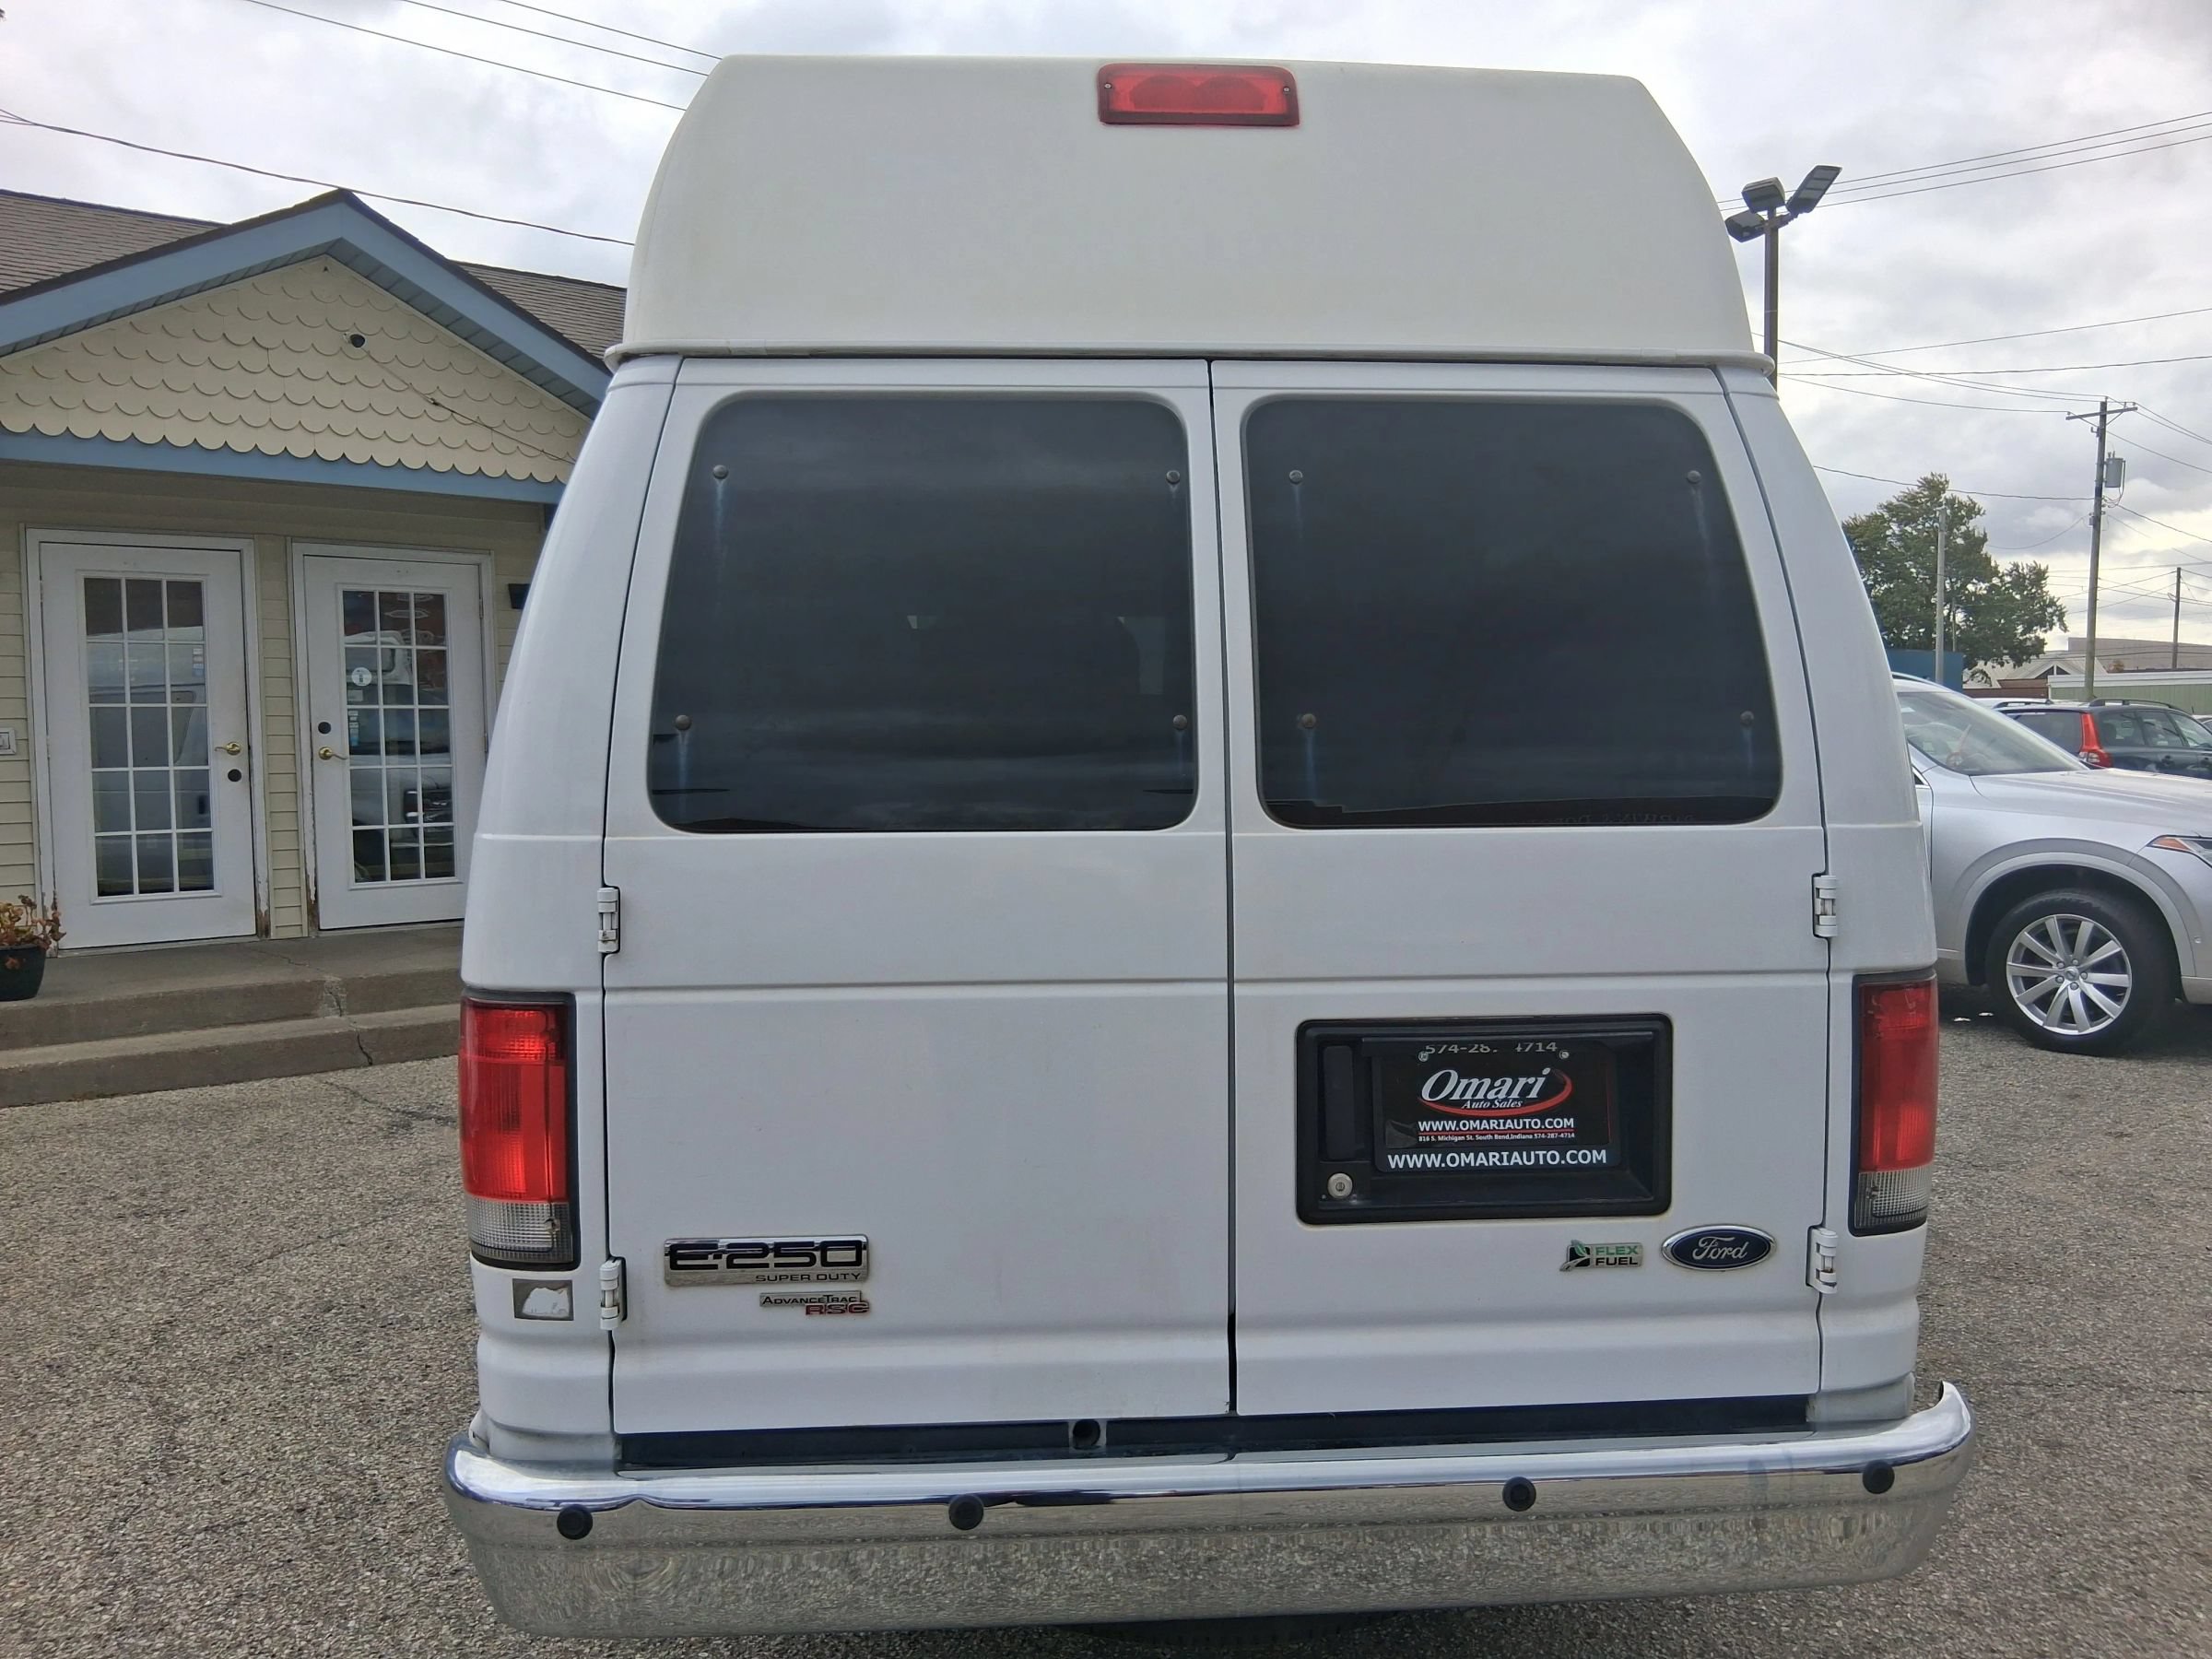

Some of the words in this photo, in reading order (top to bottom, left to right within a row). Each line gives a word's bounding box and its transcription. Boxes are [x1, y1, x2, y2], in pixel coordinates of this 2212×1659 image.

[1421, 1067, 1551, 1101] Omari
[1462, 1100, 1490, 1109] Auto
[1492, 1099, 1523, 1108] Sales
[1418, 1118, 1574, 1132] WWW.OMARIAUTO.COM
[1438, 1134, 1465, 1142] Michigan
[1388, 1150, 1606, 1169] WWW.OMARIAUTO.COM
[669, 1240, 864, 1270] E-250
[1595, 1245, 1638, 1255] FLEX
[1692, 1236, 1747, 1260] Ford
[1595, 1256, 1638, 1266] FUEL
[756, 1274, 811, 1282] SUPER
[817, 1273, 861, 1281] DUTY
[806, 1301, 869, 1315] RSC
